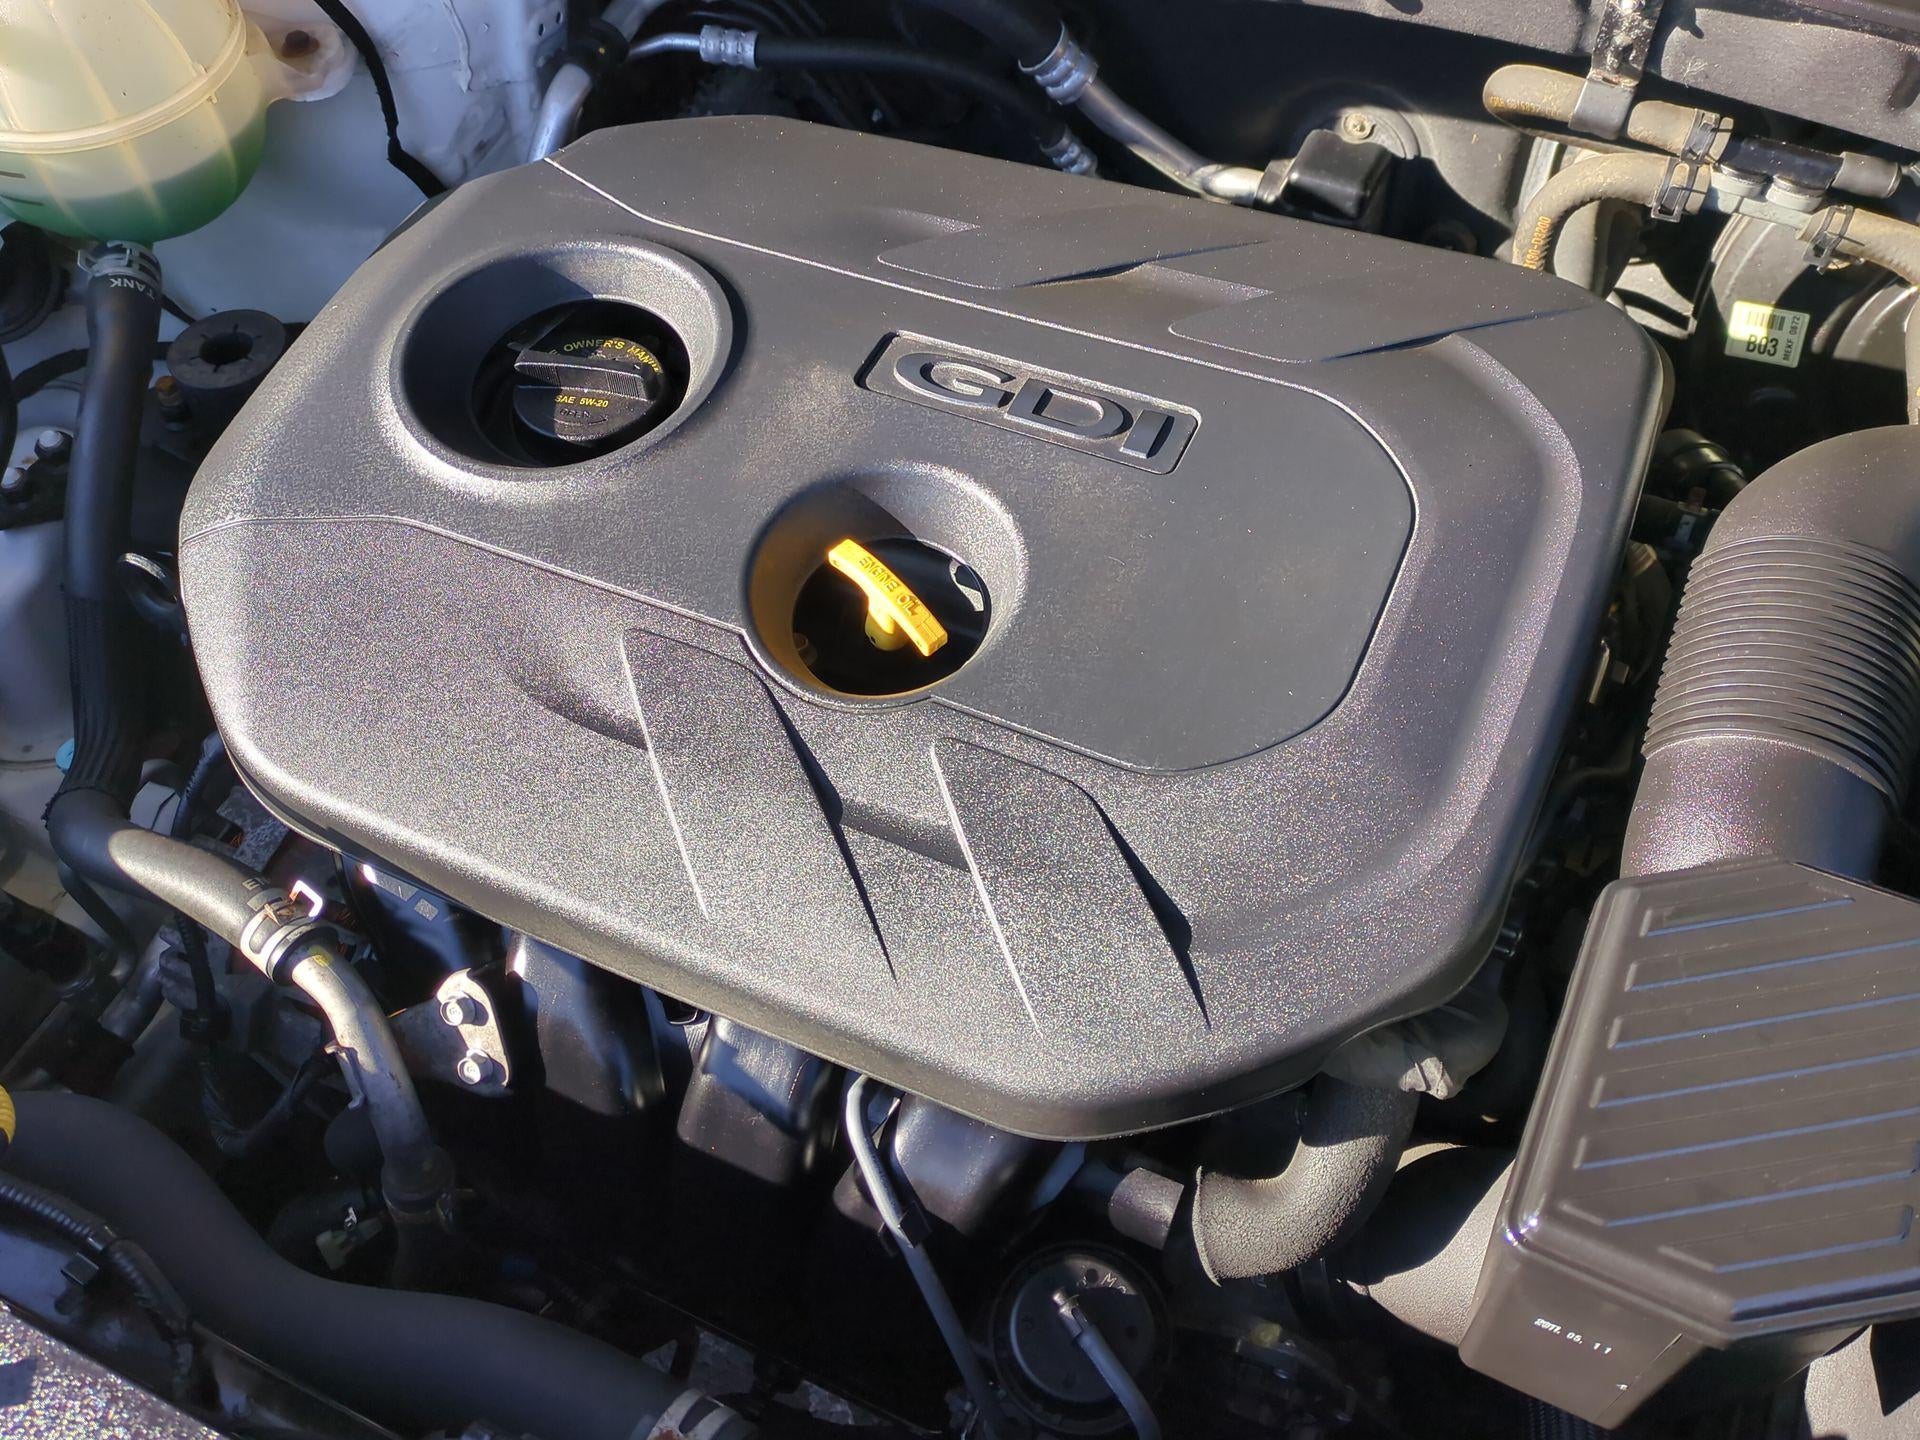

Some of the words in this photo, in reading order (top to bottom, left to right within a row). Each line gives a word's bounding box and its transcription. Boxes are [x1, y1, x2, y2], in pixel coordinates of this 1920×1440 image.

[109, 278, 155, 300] TANK
[563, 338, 626, 352] OWNER'S
[1746, 334, 1779, 357] B03
[555, 395, 576, 404] SAE
[579, 397, 609, 408] 5W-20
[893, 352, 1175, 459] GDI
[859, 556, 900, 592] ENGINE
[897, 593, 919, 616] OIL
